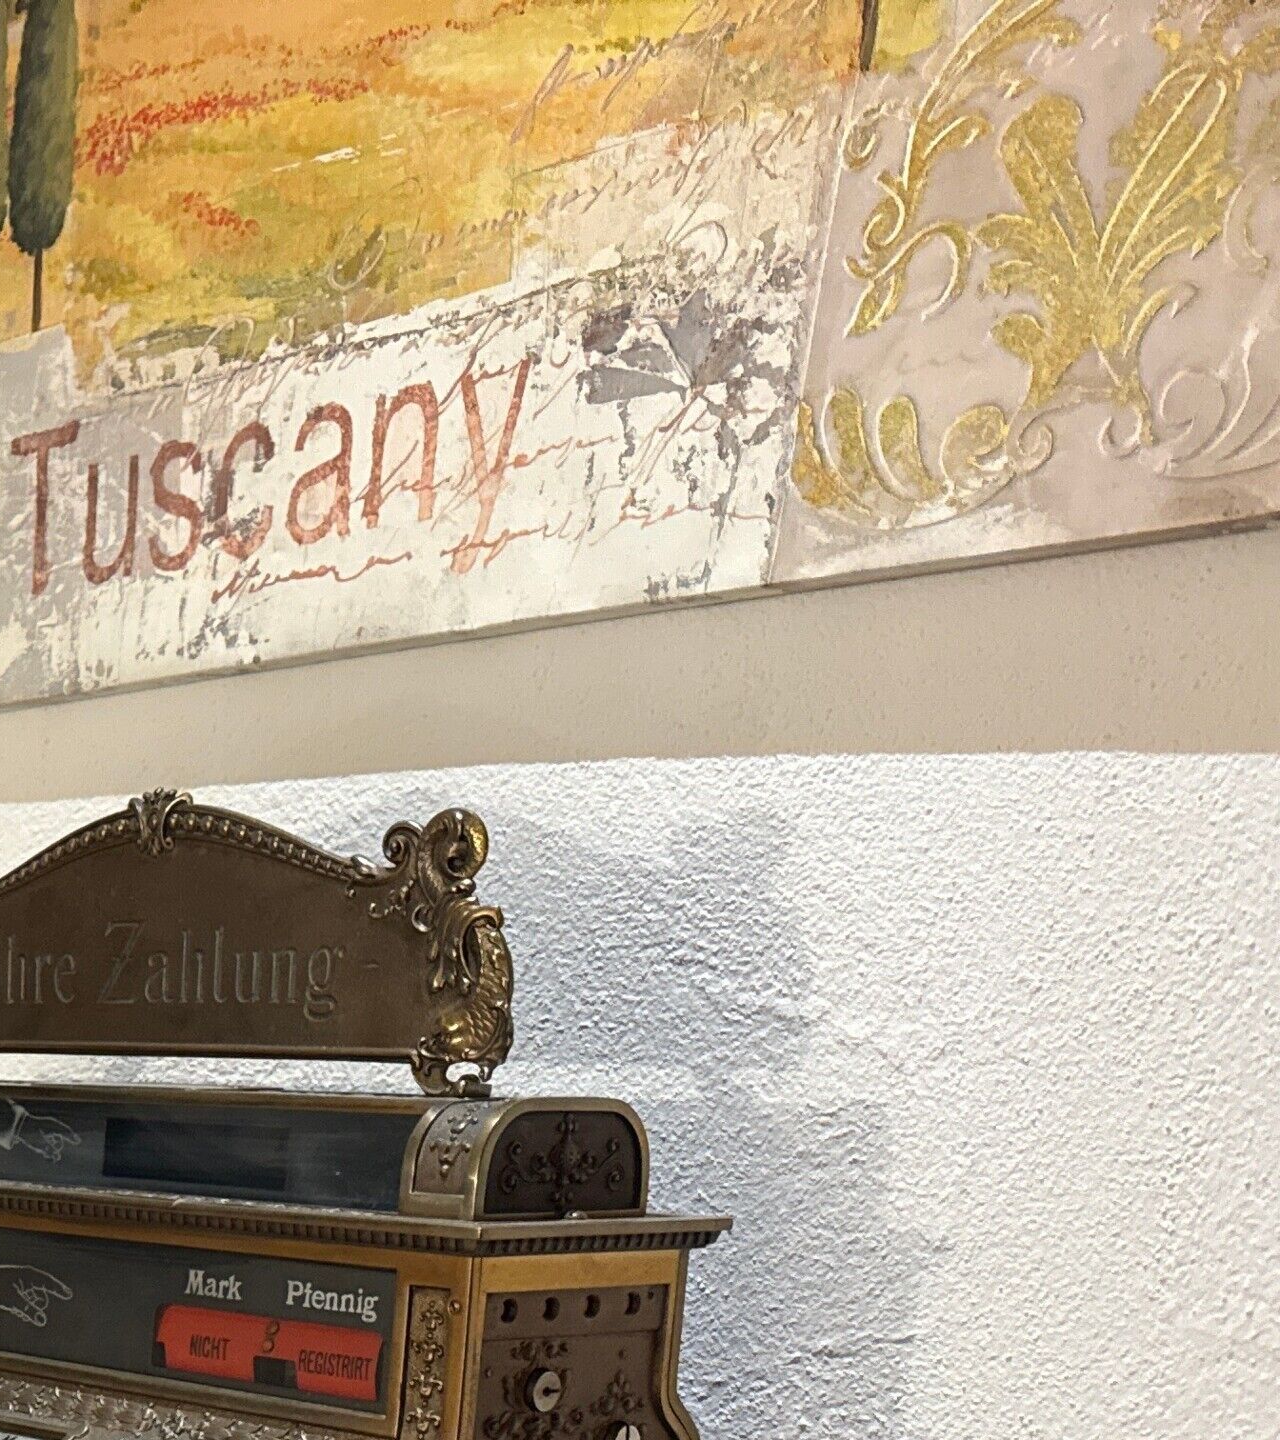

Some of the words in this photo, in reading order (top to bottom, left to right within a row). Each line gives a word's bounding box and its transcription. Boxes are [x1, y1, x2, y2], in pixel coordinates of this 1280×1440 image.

[10, 357, 531, 598] Tuscany
[96, 920, 345, 1022] Zahlung
[185, 1268, 243, 1301] Mark
[285, 1279, 379, 1323] Pfennig
[190, 1333, 231, 1362] NICHT
[298, 1348, 374, 1382] REGISTRIRT
